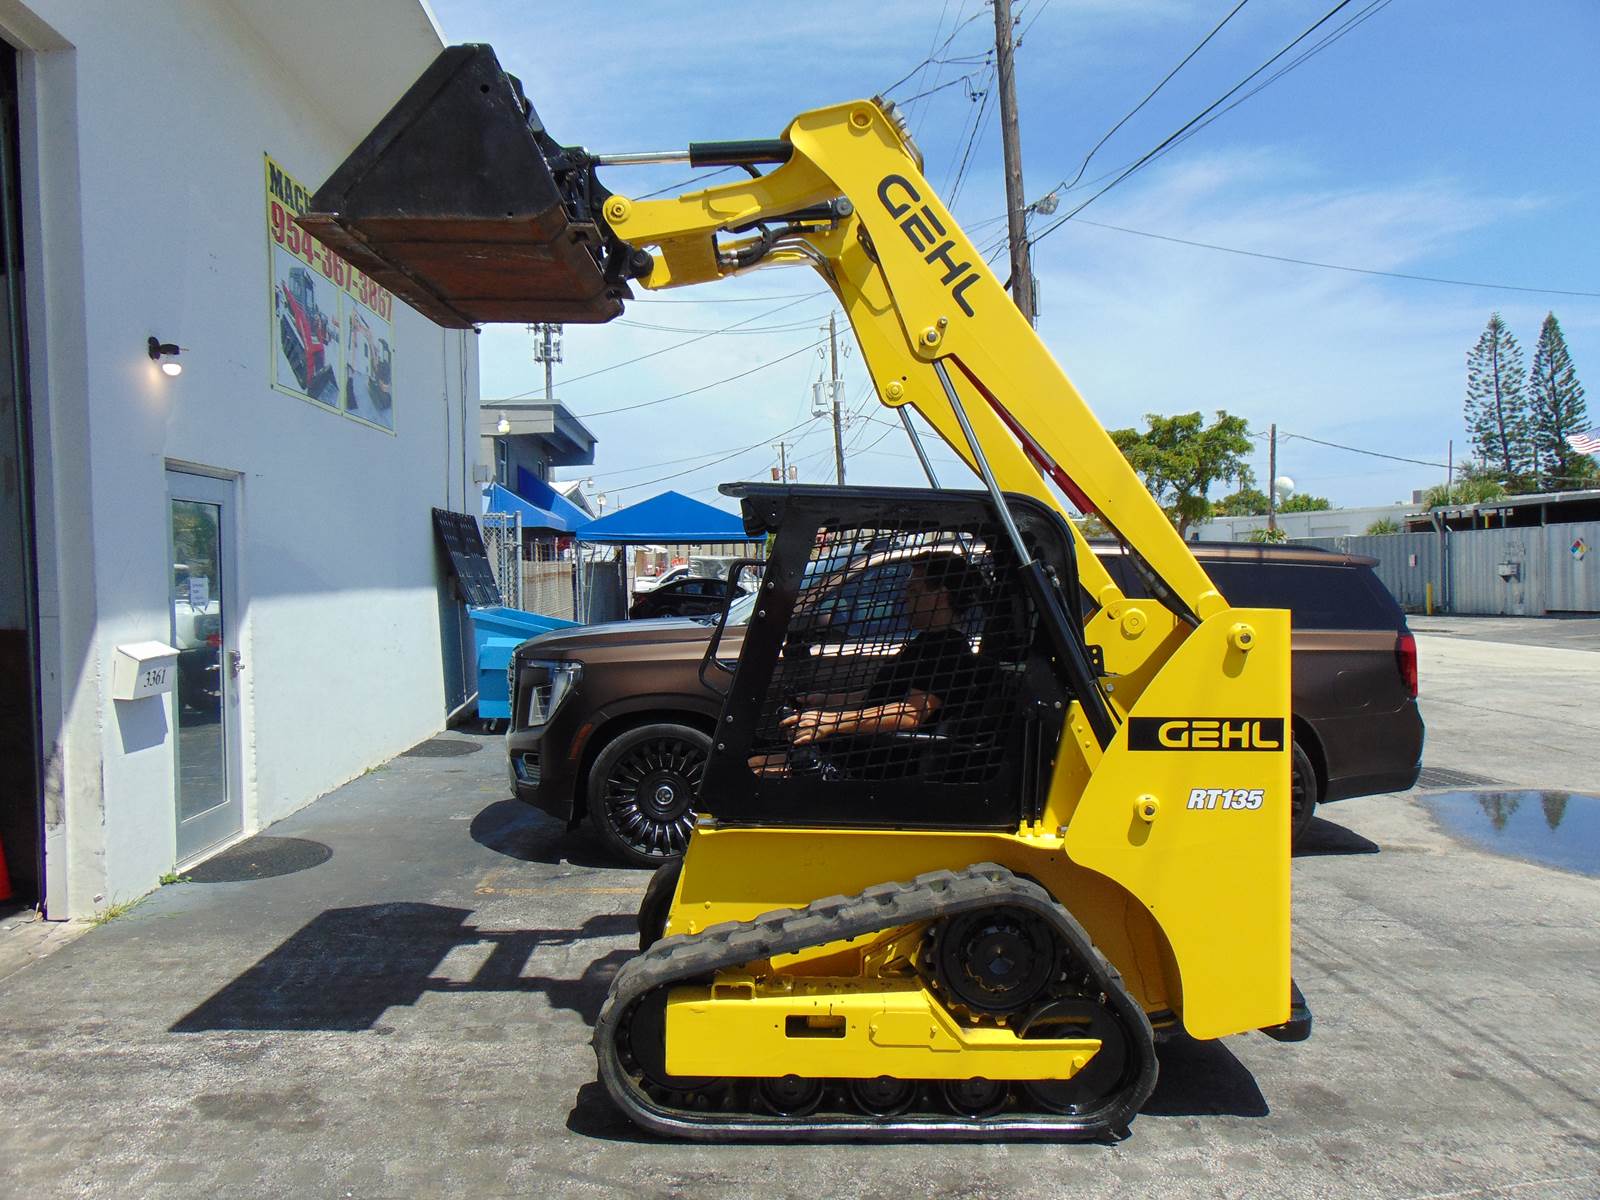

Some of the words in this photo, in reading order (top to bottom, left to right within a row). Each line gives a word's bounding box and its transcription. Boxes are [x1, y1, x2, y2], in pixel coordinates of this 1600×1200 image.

[877, 174, 981, 318] GEHL
[143, 669, 167, 688] 3361
[1158, 720, 1280, 749] GEHL
[1186, 788, 1265, 810] RT135
